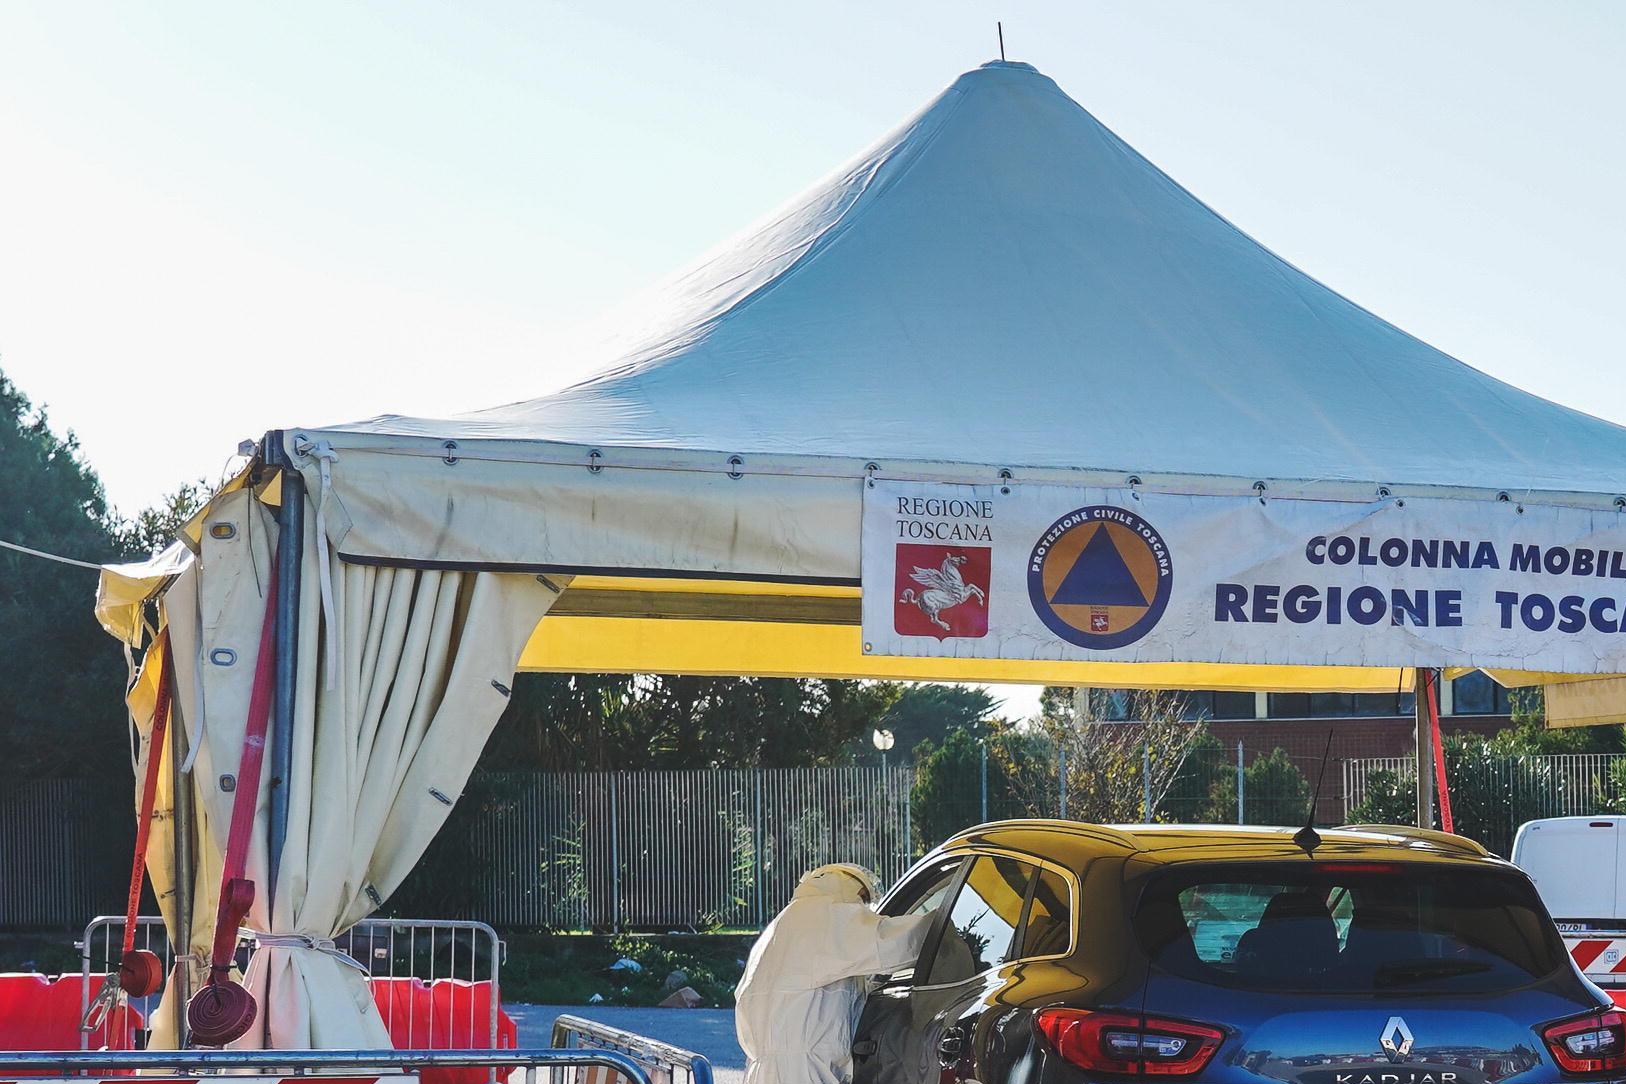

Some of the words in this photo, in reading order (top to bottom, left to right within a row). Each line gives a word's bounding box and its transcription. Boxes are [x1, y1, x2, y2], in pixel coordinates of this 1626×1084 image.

[897, 497, 994, 519] REGIONE
[896, 520, 992, 542] TOSCANA
[1032, 511, 1088, 573] PROTEZIONE
[1094, 509, 1133, 526] CIVILE
[1136, 523, 1170, 577] TOSCANA
[1305, 536, 1500, 569] COLONNA
[1214, 583, 1463, 627] REGIONE
